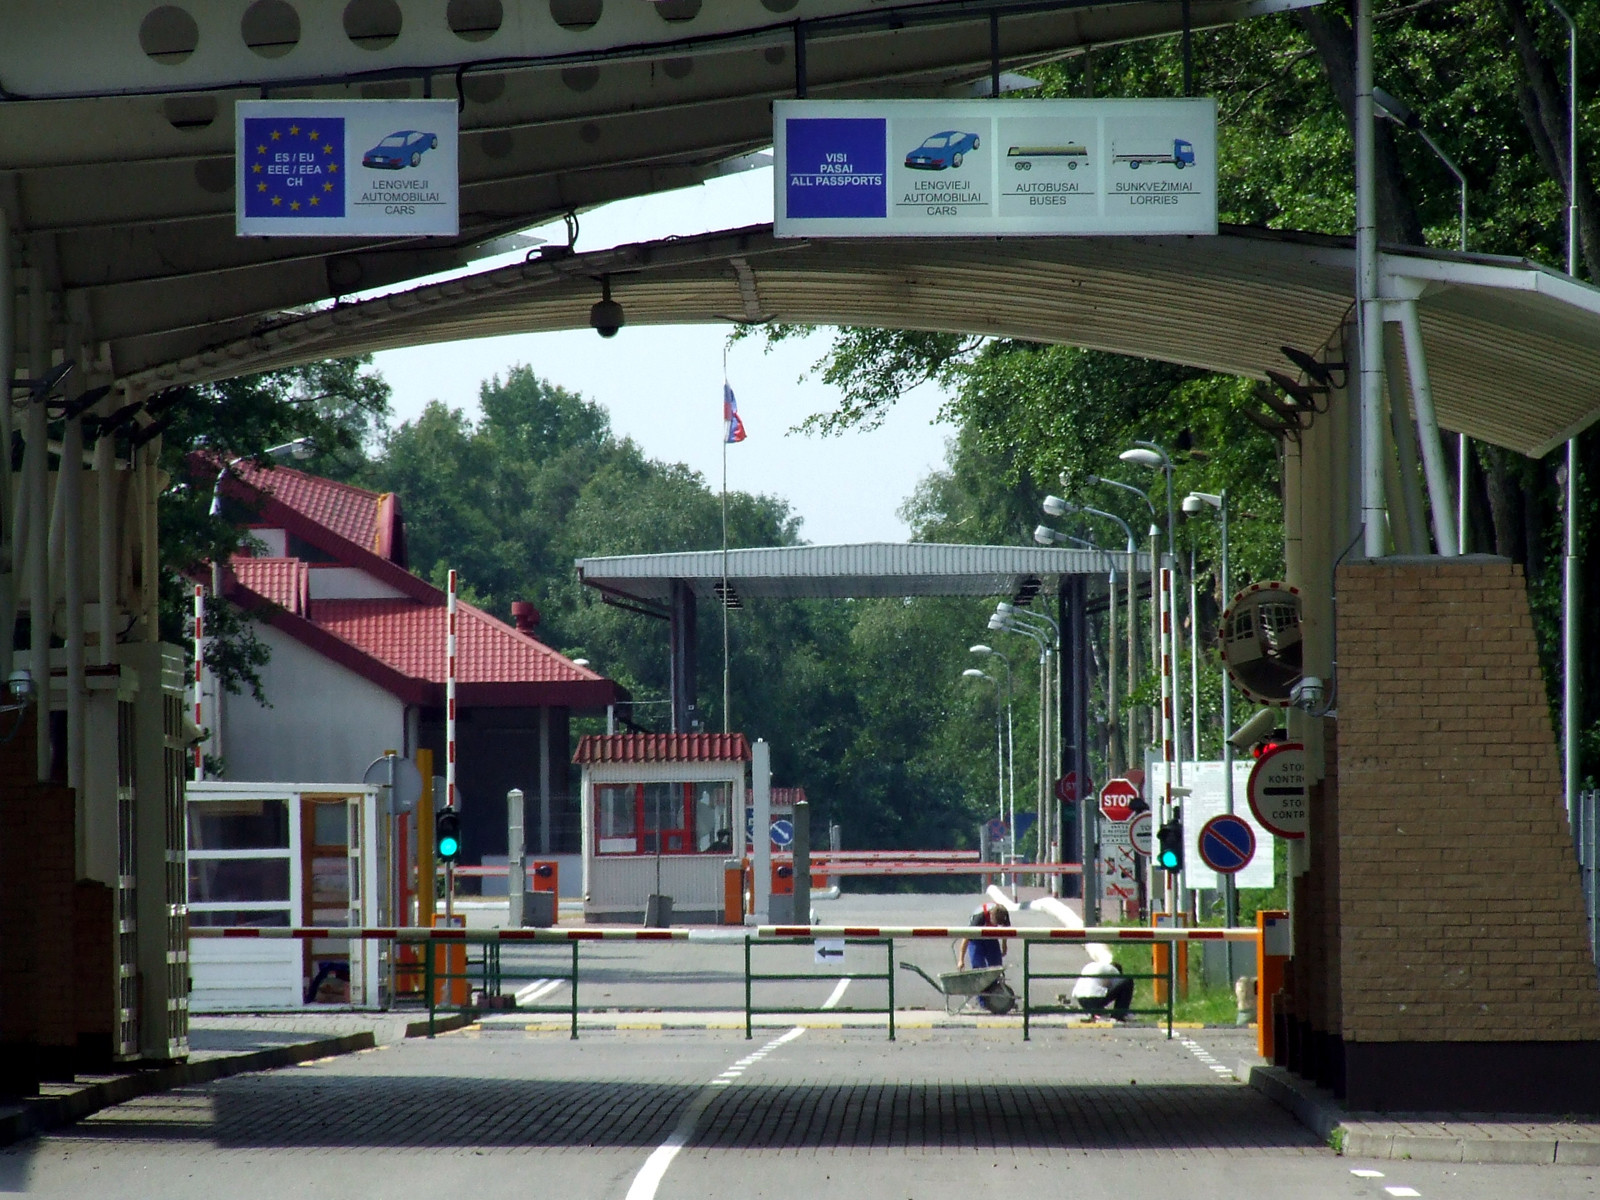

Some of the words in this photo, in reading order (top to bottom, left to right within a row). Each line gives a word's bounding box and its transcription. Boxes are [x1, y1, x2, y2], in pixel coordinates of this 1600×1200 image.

[275, 153, 288, 162] ES
[299, 153, 315, 162] EU
[826, 153, 847, 162] VISI
[268, 165, 290, 174] EEE
[299, 165, 322, 174] EEA
[820, 165, 853, 173] PASAI
[287, 177, 303, 187] CH
[372, 180, 428, 189] LENGVIEJI
[791, 177, 813, 186] ALL
[816, 177, 882, 186] PASSPORTS
[915, 181, 970, 190] LENGVIEJI
[1115, 181, 1193, 191] SUNKVEŽIMIAI
[1016, 183, 1079, 192] AUTOBUSAI
[362, 192, 439, 202] AUTOMOBILIAI
[904, 192, 981, 202] AUTOMOBILIAI
[1030, 196, 1066, 205] BUSES
[1130, 196, 1178, 205] LORRIES
[385, 206, 415, 215] CARS
[927, 207, 957, 216] CARS
[1282, 763, 1304, 772] STO
[1269, 775, 1304, 783] KONTR
[1282, 800, 1304, 808] STO
